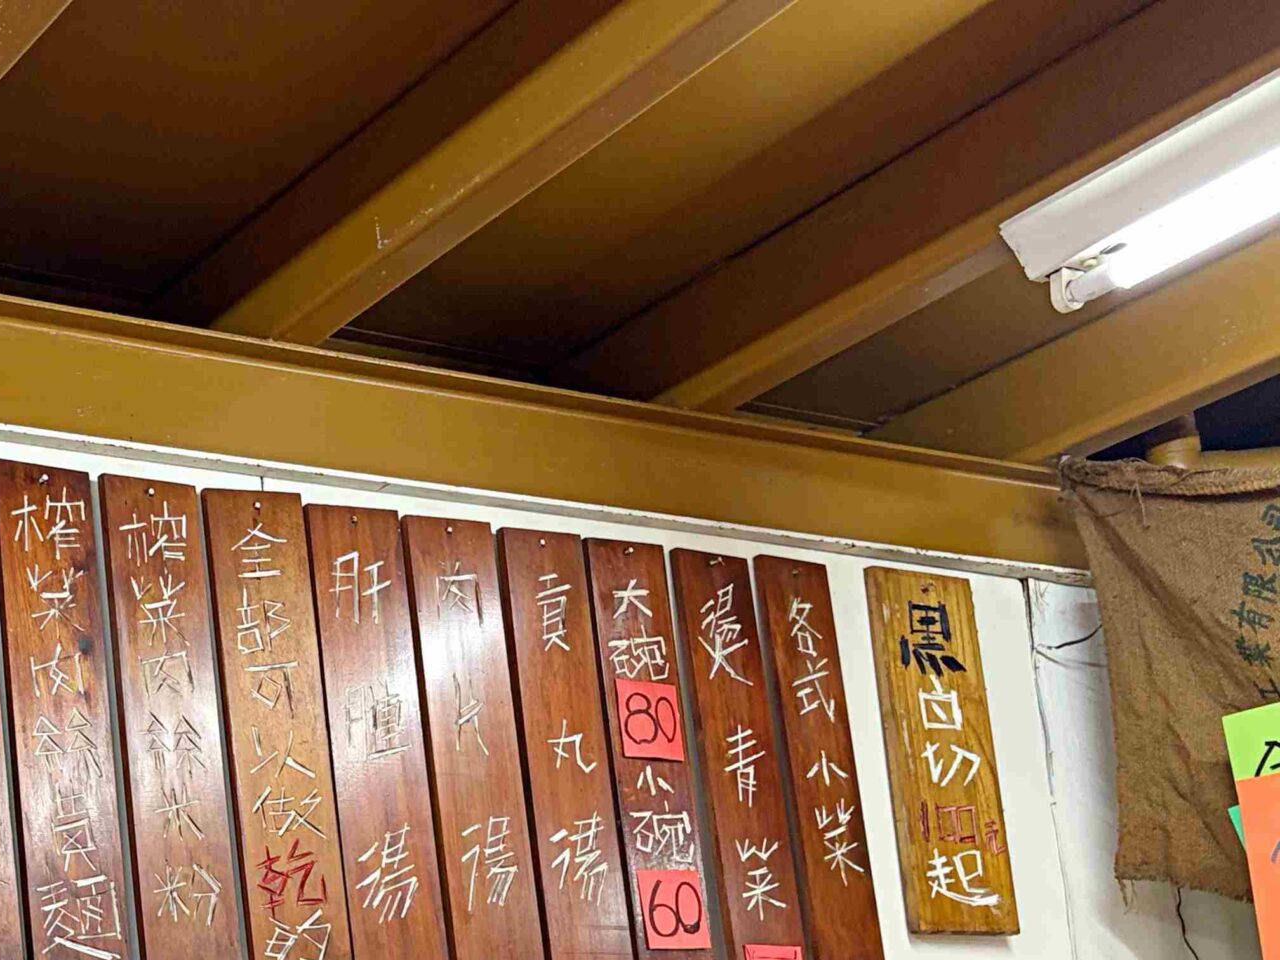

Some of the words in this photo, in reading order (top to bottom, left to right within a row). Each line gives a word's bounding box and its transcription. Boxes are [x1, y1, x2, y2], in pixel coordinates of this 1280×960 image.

[119, 501, 223, 927] 榨菜肉絲米粉
[608, 578, 670, 681] 大碗
[624, 691, 678, 745] 80
[535, 573, 610, 907] 貢丸湯
[632, 764, 695, 863] 小碗
[698, 583, 787, 921] 燙青菜
[789, 598, 865, 887] 各式小菜
[648, 880, 702, 938] 60
